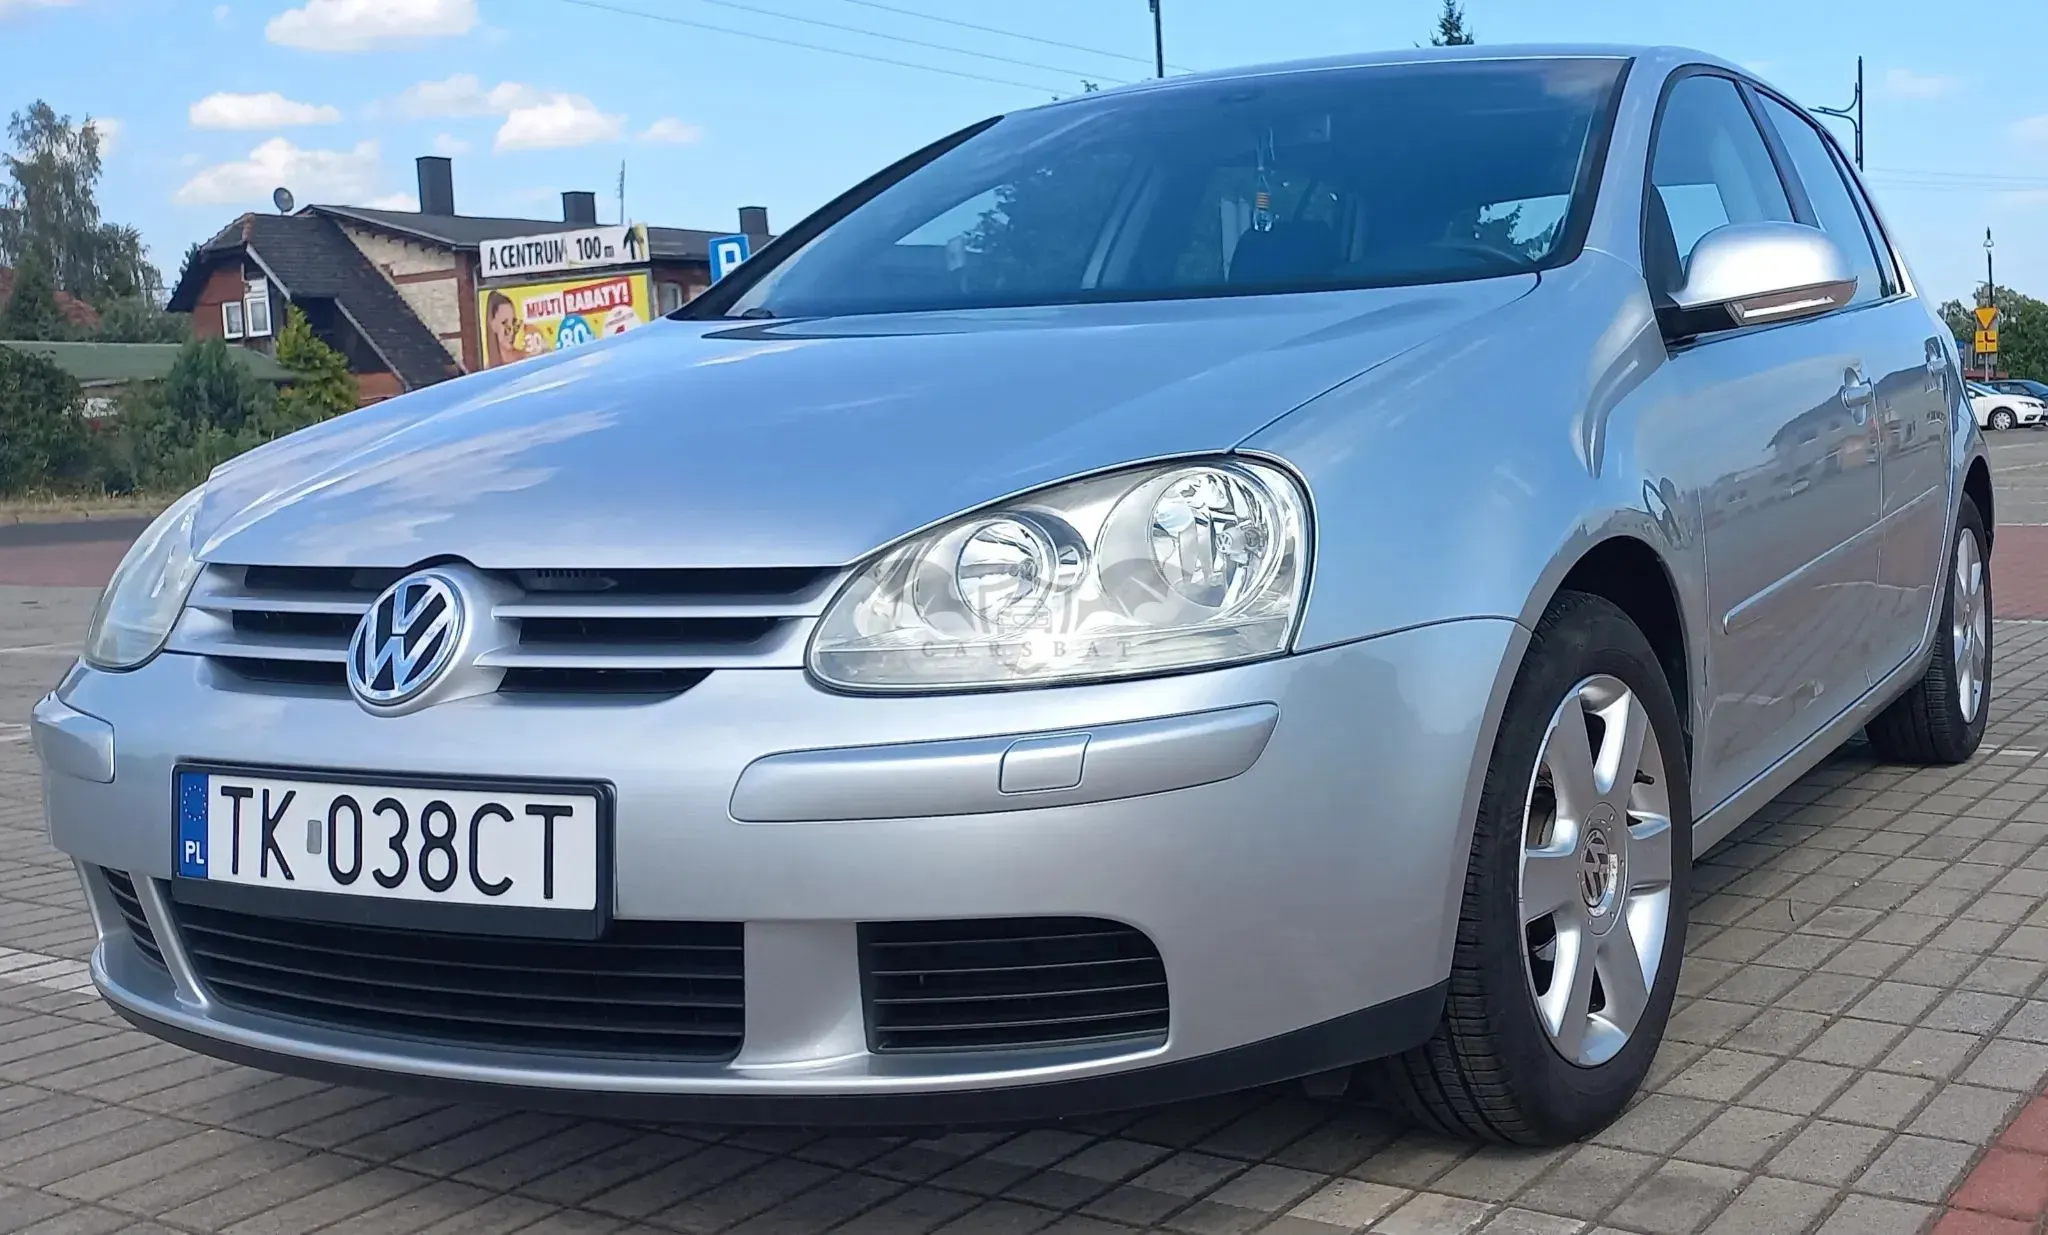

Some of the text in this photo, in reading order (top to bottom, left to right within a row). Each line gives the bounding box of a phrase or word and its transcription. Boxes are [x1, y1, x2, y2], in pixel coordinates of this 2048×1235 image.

[489, 247, 499, 271] A
[500, 238, 567, 269] CENTRUM
[576, 235, 601, 261] 100
[718, 242, 742, 280] P
[526, 281, 630, 318] MULTI RABATY!
[185, 840, 205, 865] PL
[220, 785, 575, 902] TK 038CT
